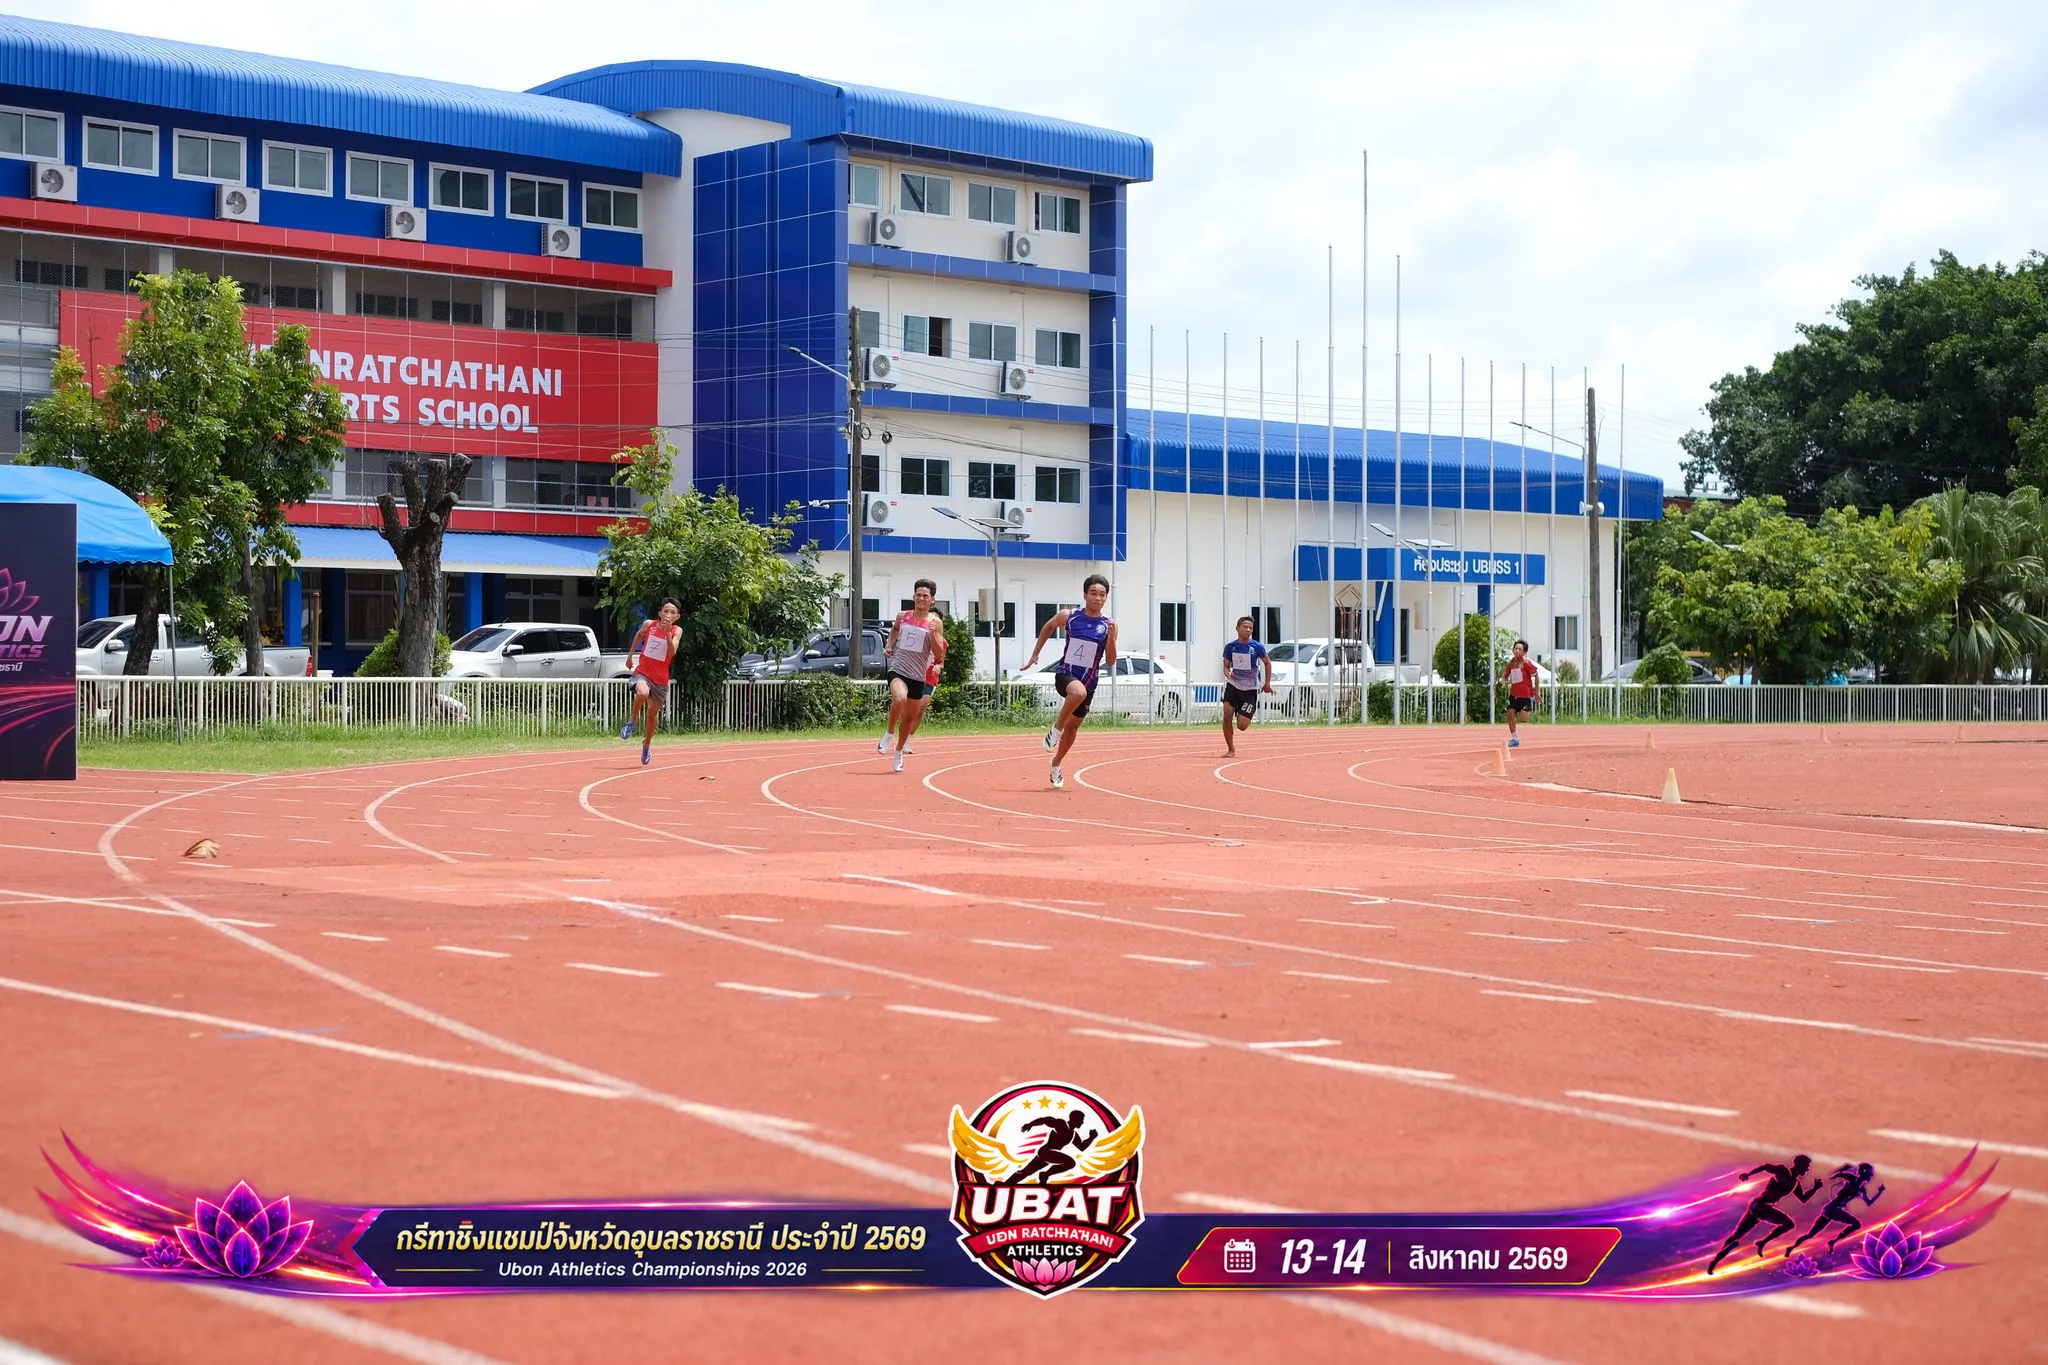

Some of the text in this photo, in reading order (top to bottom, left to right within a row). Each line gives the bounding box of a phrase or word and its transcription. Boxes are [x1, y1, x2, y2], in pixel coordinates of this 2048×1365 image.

[250, 344, 562, 397] NRATCHATHANI
[418, 397, 539, 434] SCHOOL
[1514, 561, 1520, 575] 1
[649, 640, 661, 654] 7
[906, 632, 917, 647] 5
[1073, 644, 1085, 662] 4
